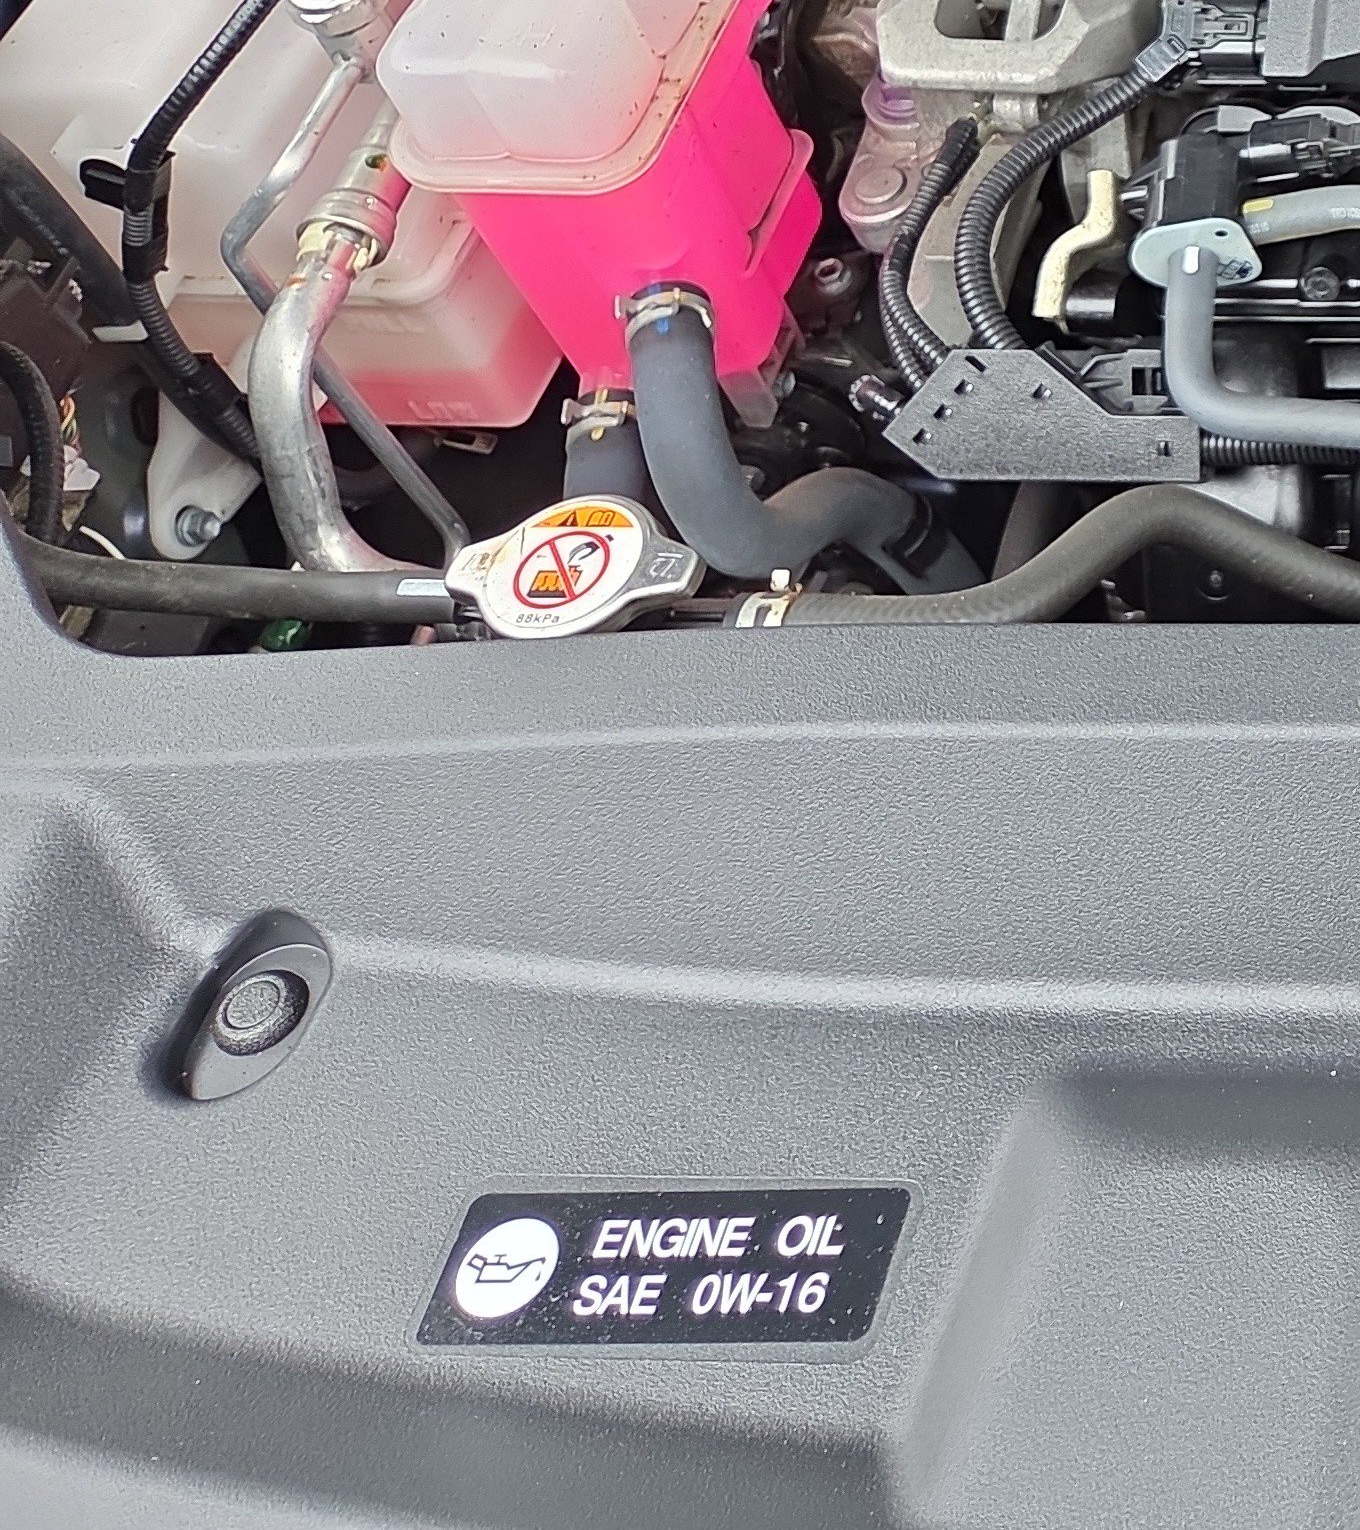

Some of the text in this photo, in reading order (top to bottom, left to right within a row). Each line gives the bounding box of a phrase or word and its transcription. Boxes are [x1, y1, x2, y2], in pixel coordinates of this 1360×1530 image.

[515, 613, 560, 624] 88kPa
[592, 1214, 845, 1259] ENGINE OIL
[572, 1271, 831, 1316] SAE 0W-16
